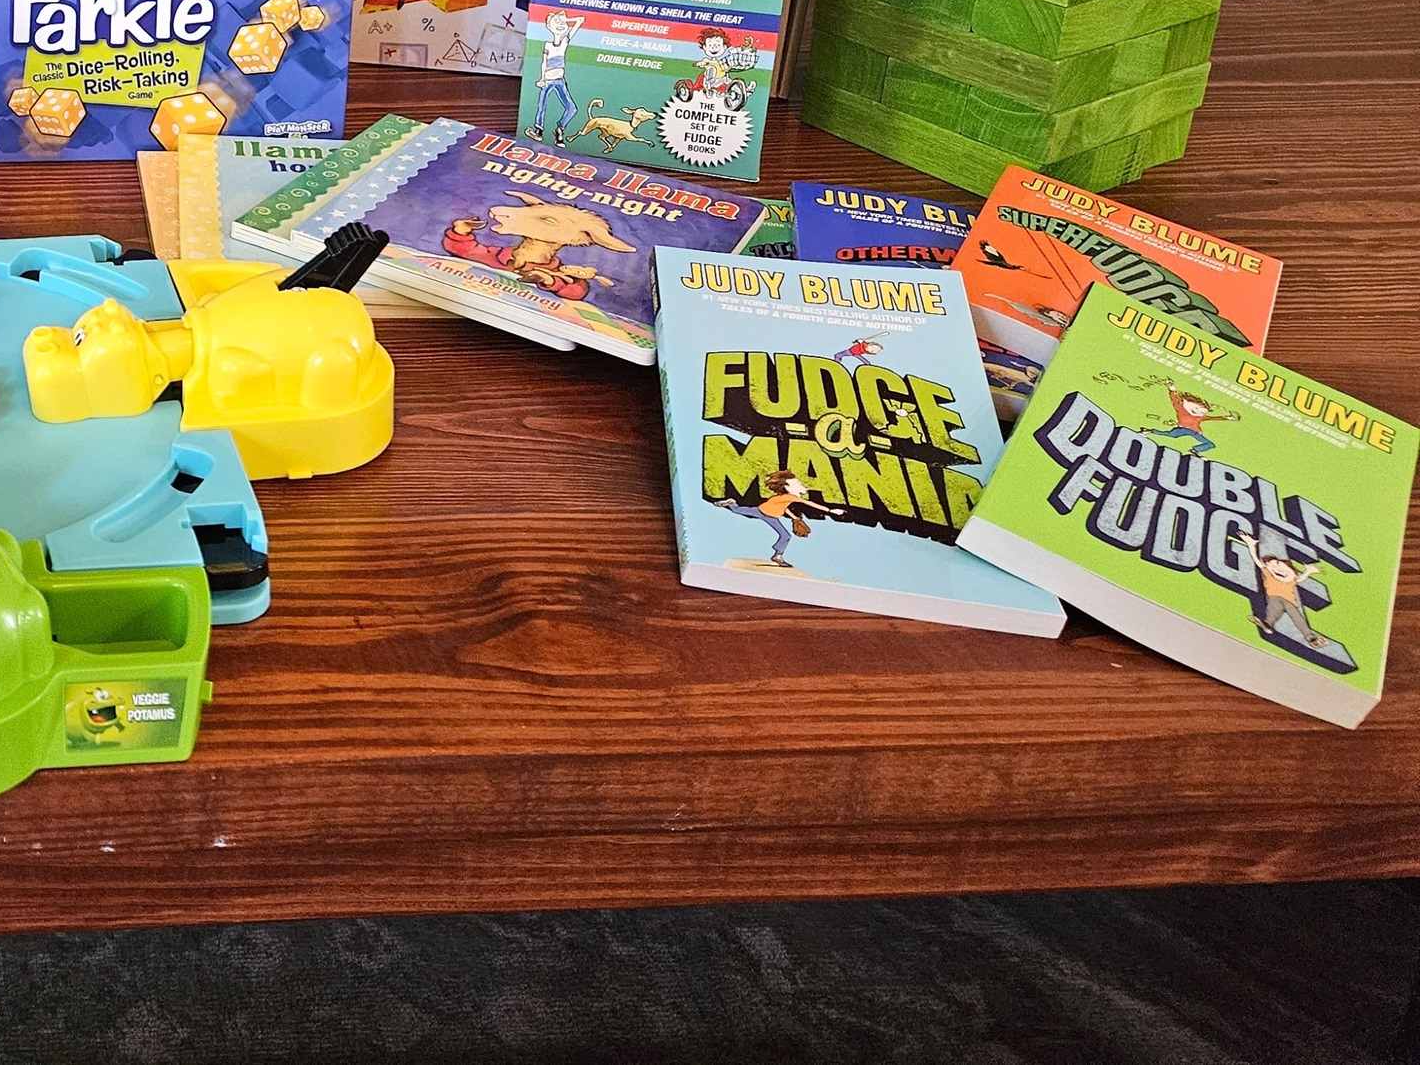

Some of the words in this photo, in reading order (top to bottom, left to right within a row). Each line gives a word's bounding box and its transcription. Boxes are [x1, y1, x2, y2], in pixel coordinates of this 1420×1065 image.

[611, 1, 645, 13] KNOWN
[646, 6, 659, 15] AS
[660, 8, 692, 19] SHEILA
[695, 12, 713, 21] THE
[714, 14, 744, 25] GREAT
[611, 20, 670, 34] SUPERFUDGE
[601, 37, 672, 53] FUDGE-A-MANIA
[45, 62, 62, 71] The
[66, 50, 180, 77] Dice-Rolling,
[597, 54, 631, 66] DOUBLE
[633, 59, 663, 70] FUDGE
[32, 71, 64, 83] Classic
[84, 70, 189, 95] Risk-Taking
[128, 90, 153, 100] Game
[700, 102, 715, 111] THE
[675, 109, 737, 125] COMPLETE
[690, 123, 705, 131] SET
[684, 133, 722, 146] FUDGE
[234, 141, 338, 159] llam
[688, 145, 715, 155] BOOKS
[470, 134, 597, 181] llama
[603, 169, 740, 220] llama
[483, 158, 683, 222] nighty-night
[816, 190, 908, 215] JUDY
[1021, 178, 1121, 218] JUDY
[1129, 213, 1263, 274] BLUME
[430, 260, 479, 286] Anna
[481, 276, 562, 311] Dewdney
[681, 263, 784, 299] JUDY
[800, 275, 946, 315] BLUME
[1108, 307, 1228, 370] JUDY
[1236, 361, 1396, 453] BLUME
[702, 351, 981, 466] FUDGE
[1034, 391, 1362, 573] DOUBLE
[1047, 456, 1358, 674] FUDGE
[131, 691, 171, 707] VEGGIE
[127, 706, 176, 722] POTAMUS
